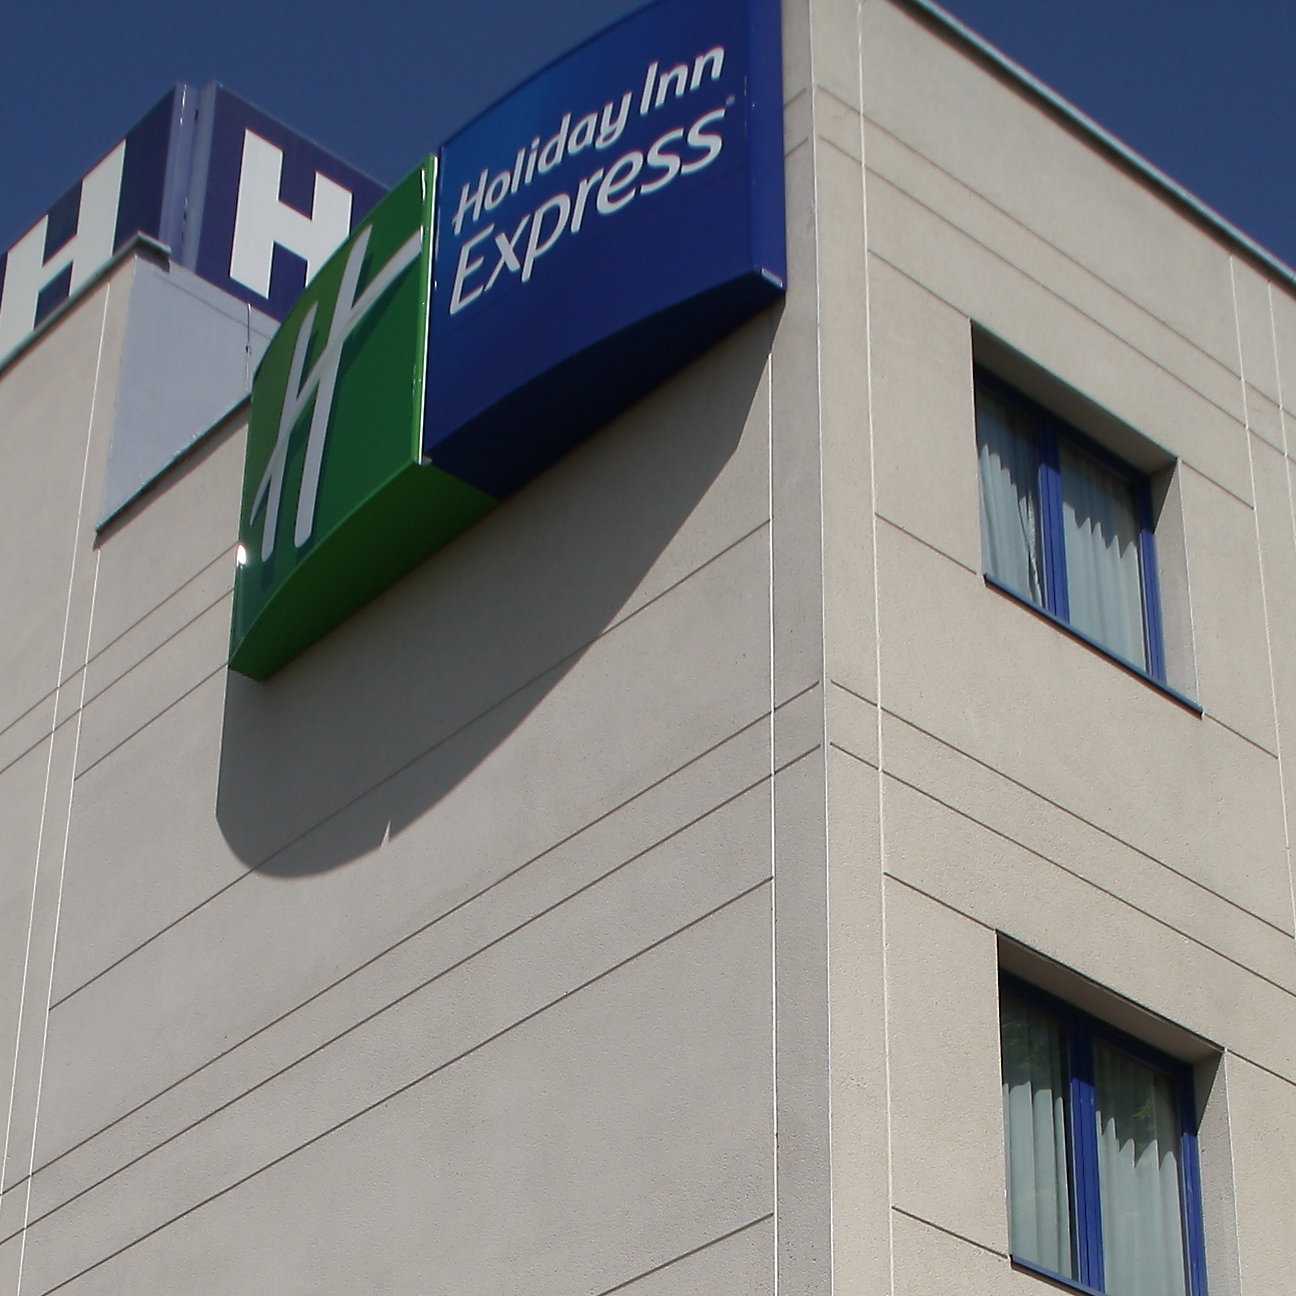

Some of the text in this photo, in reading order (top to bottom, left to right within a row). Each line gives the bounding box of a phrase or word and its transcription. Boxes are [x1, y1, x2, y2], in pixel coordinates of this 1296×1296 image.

[229, 128, 353, 300] H
[449, 108, 726, 316] Express
[452, 46, 725, 236] Holiday Inn
